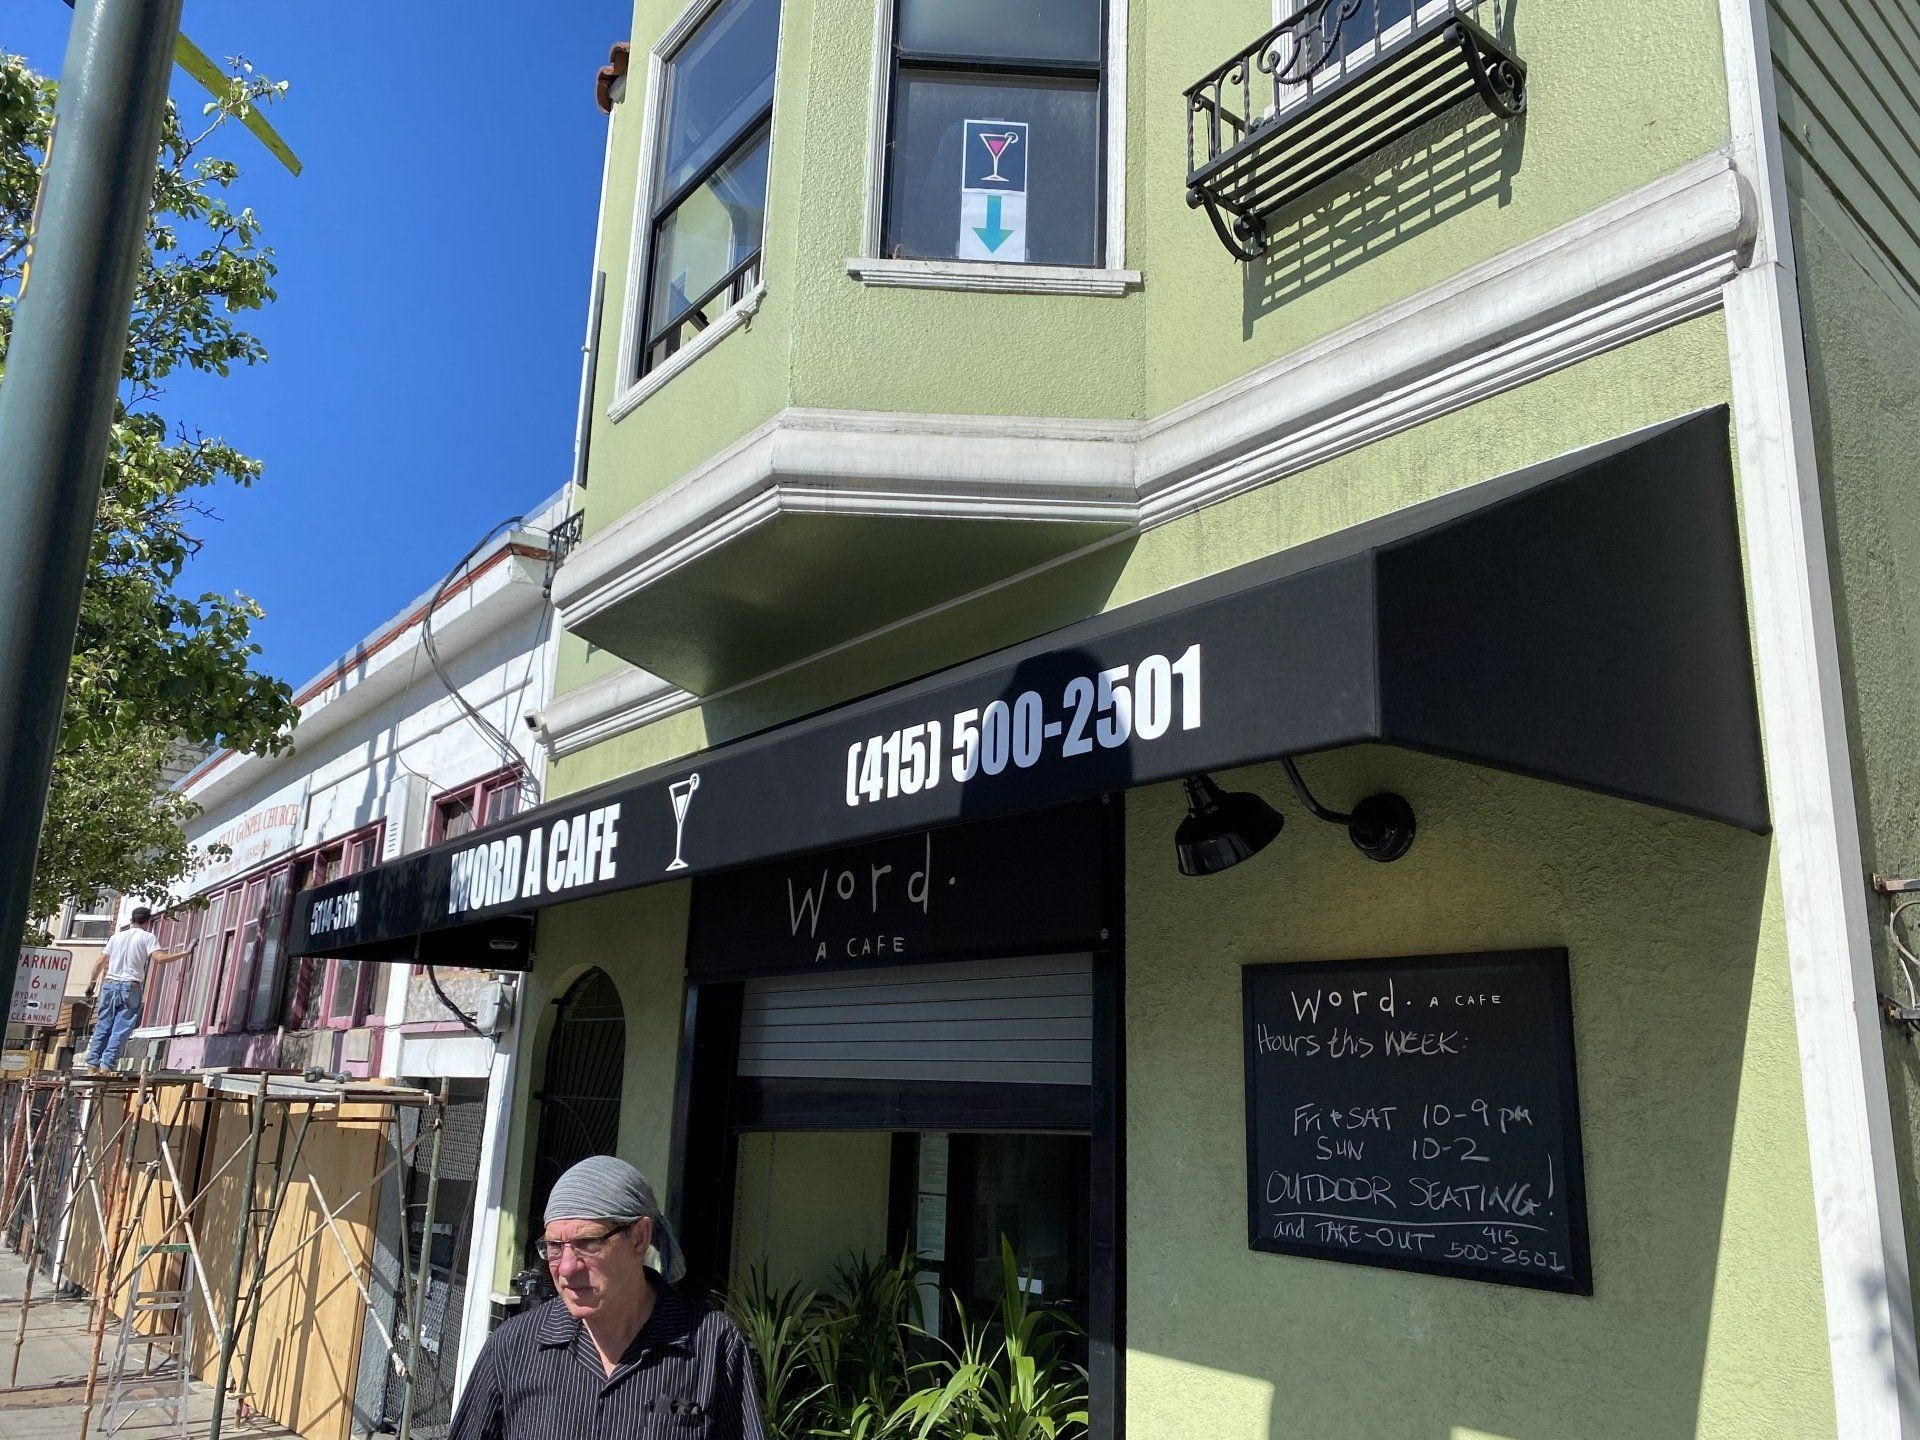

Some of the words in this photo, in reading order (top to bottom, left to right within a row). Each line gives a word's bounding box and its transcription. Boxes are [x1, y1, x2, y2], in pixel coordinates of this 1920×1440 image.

[846, 720, 941, 807] (415)
[951, 643, 1201, 783] 500-2501
[263, 804, 300, 830] CHURCH
[448, 834, 523, 914] WORD
[521, 827, 543, 898] A
[547, 803, 621, 893] CAFE
[310, 890, 360, 936] 5114-5116
[815, 941, 827, 963] A
[847, 935, 905, 957] CAFE
[31, 975, 41, 989] 6
[11, 1012, 52, 1022] CLEANING
[1429, 995, 1439, 1008] A
[1454, 994, 1502, 1006] CAFE
[1257, 1024, 1321, 1057] Hours
[1327, 1027, 1374, 1059] this
[1294, 1102, 1322, 1137] Fri
[1346, 1106, 1398, 1132] SAT
[1423, 1098, 1490, 1130] 10-9
[1316, 1135, 1365, 1161] SUN
[1412, 1137, 1491, 1162] 10-2
[1266, 1170, 1397, 1209] OUTDOOR
[1273, 1217, 1305, 1240] and
[1315, 1221, 1436, 1252] TAKE-OUT
[1482, 1225, 1520, 1246] 415
[1443, 1241, 1567, 1273] 500-2501
